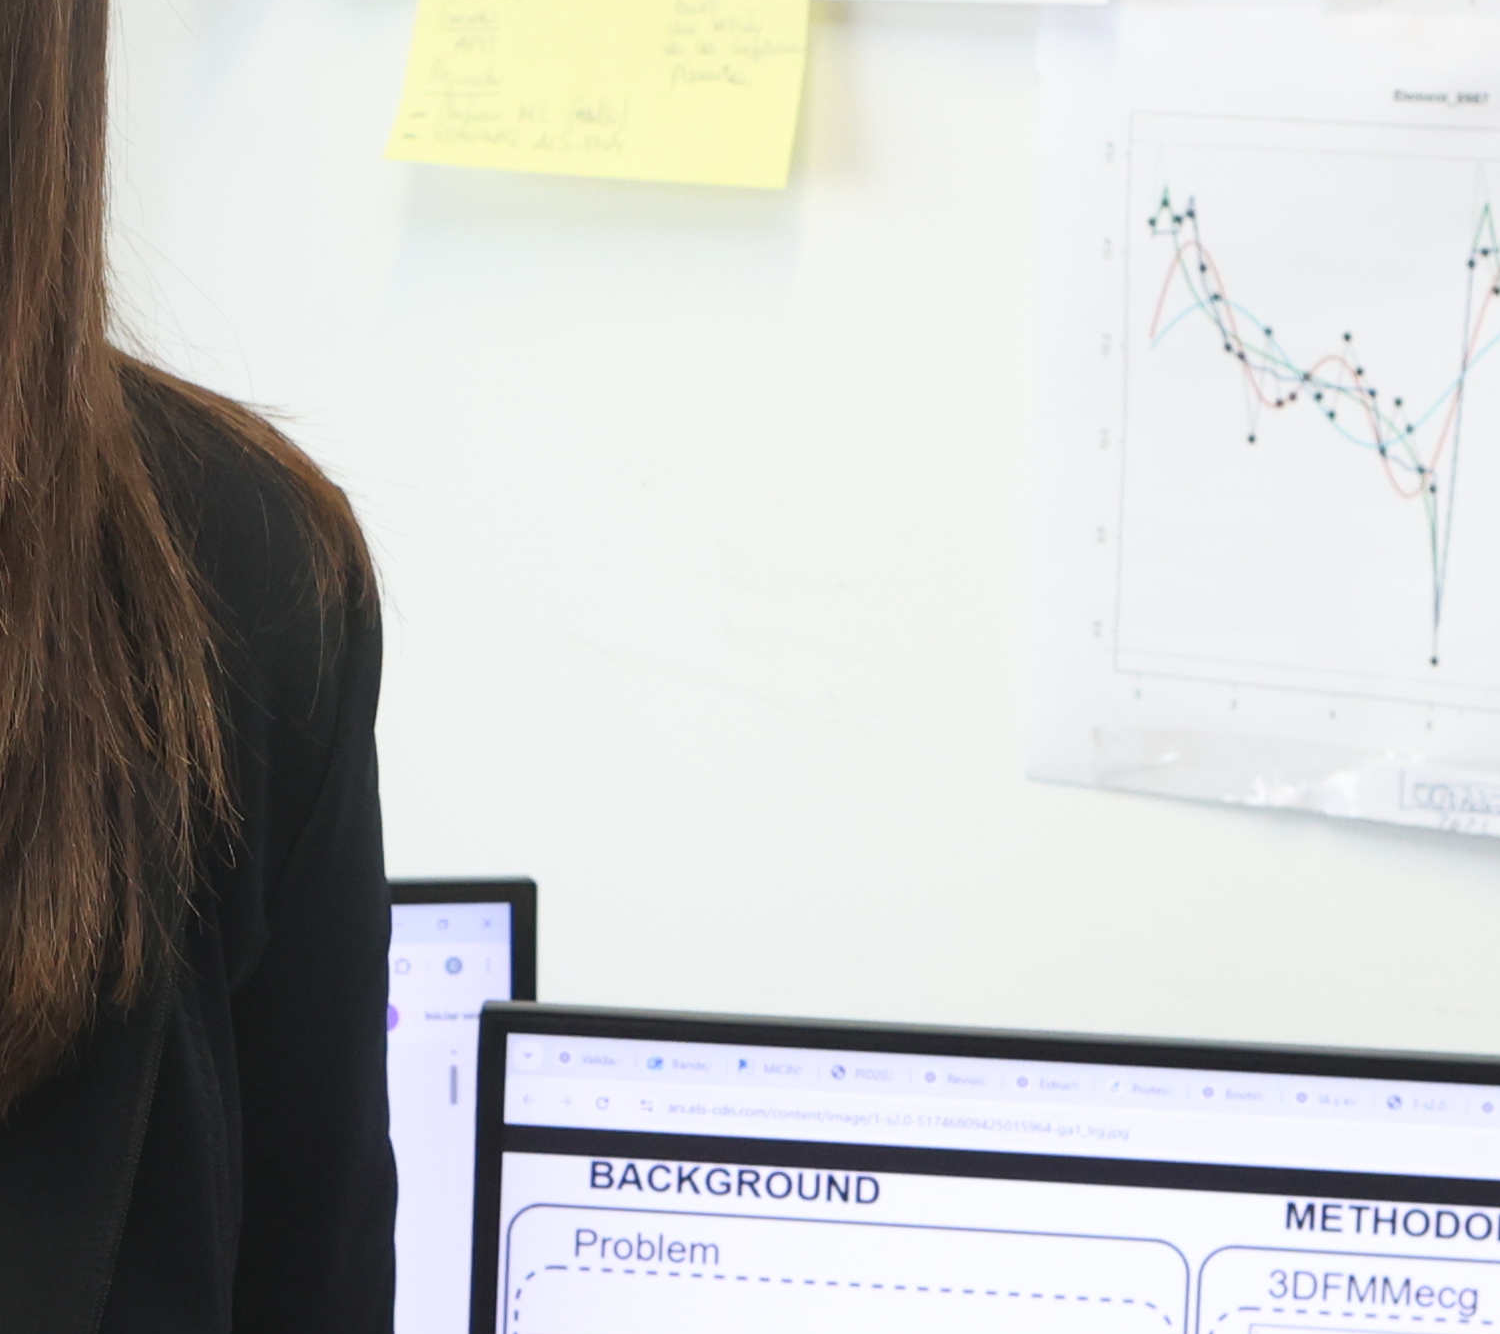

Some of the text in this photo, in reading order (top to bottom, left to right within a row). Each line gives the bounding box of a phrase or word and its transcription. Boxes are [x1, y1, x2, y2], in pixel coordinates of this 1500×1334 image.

[590, 1157, 883, 1204] BACKGROUND
[574, 1227, 720, 1265] Problem
[1268, 1269, 1479, 1319] 3DFMMecg
